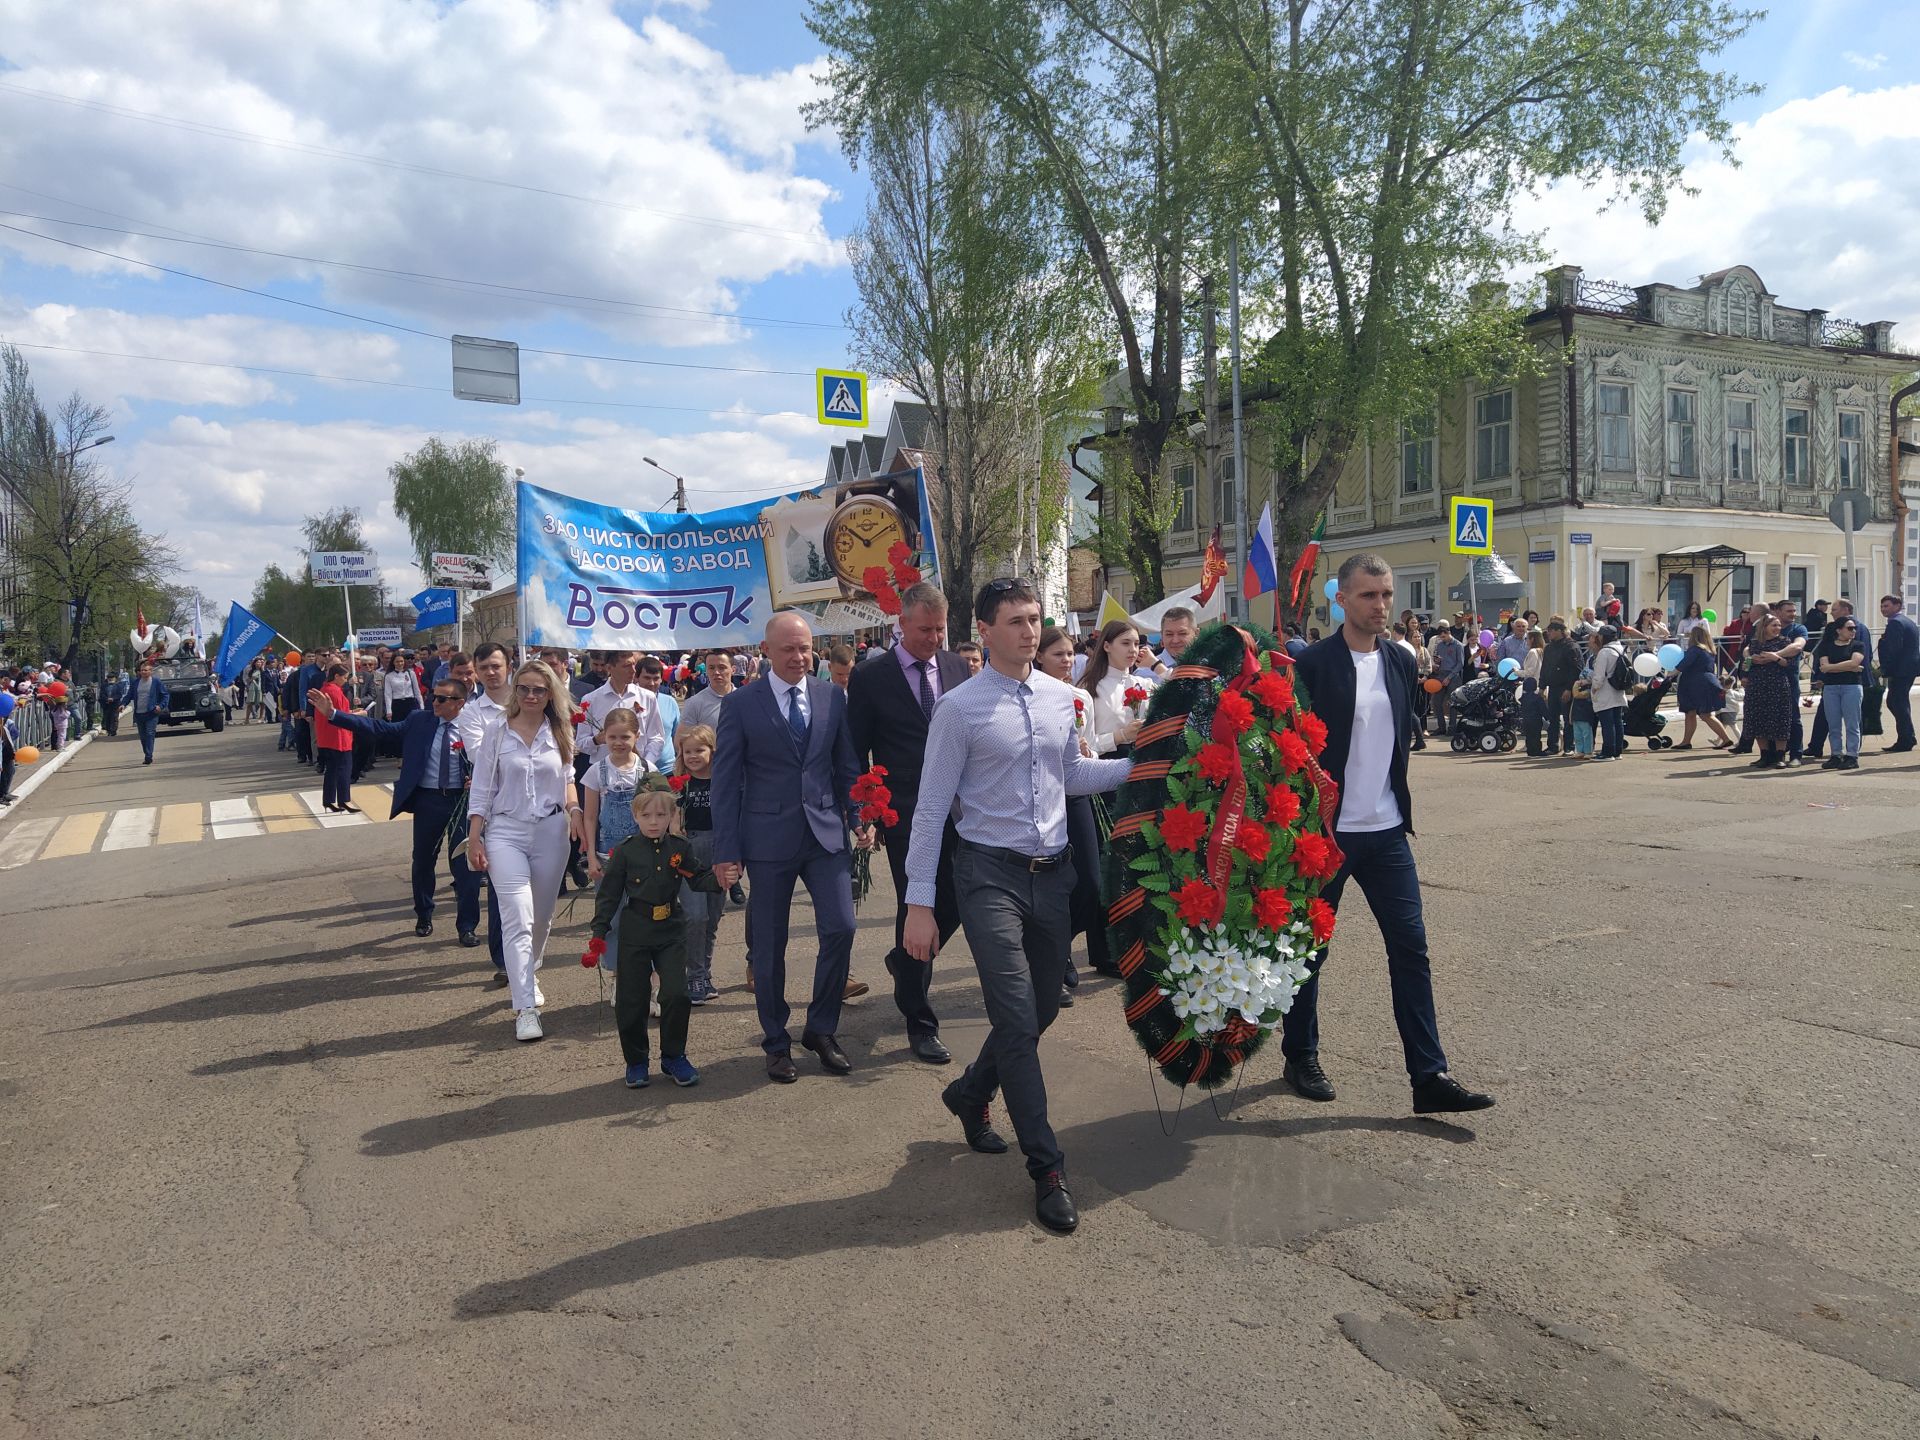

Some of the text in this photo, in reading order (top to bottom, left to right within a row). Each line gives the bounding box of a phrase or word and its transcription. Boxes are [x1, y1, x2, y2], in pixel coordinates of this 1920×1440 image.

[542, 513, 775, 551] ЗАО ЧИСТОПОЛЬСКИЙ
[340, 555, 365, 567] Фирма
[569, 546, 751, 573] ЧАСОВОЙ ЗАВОД
